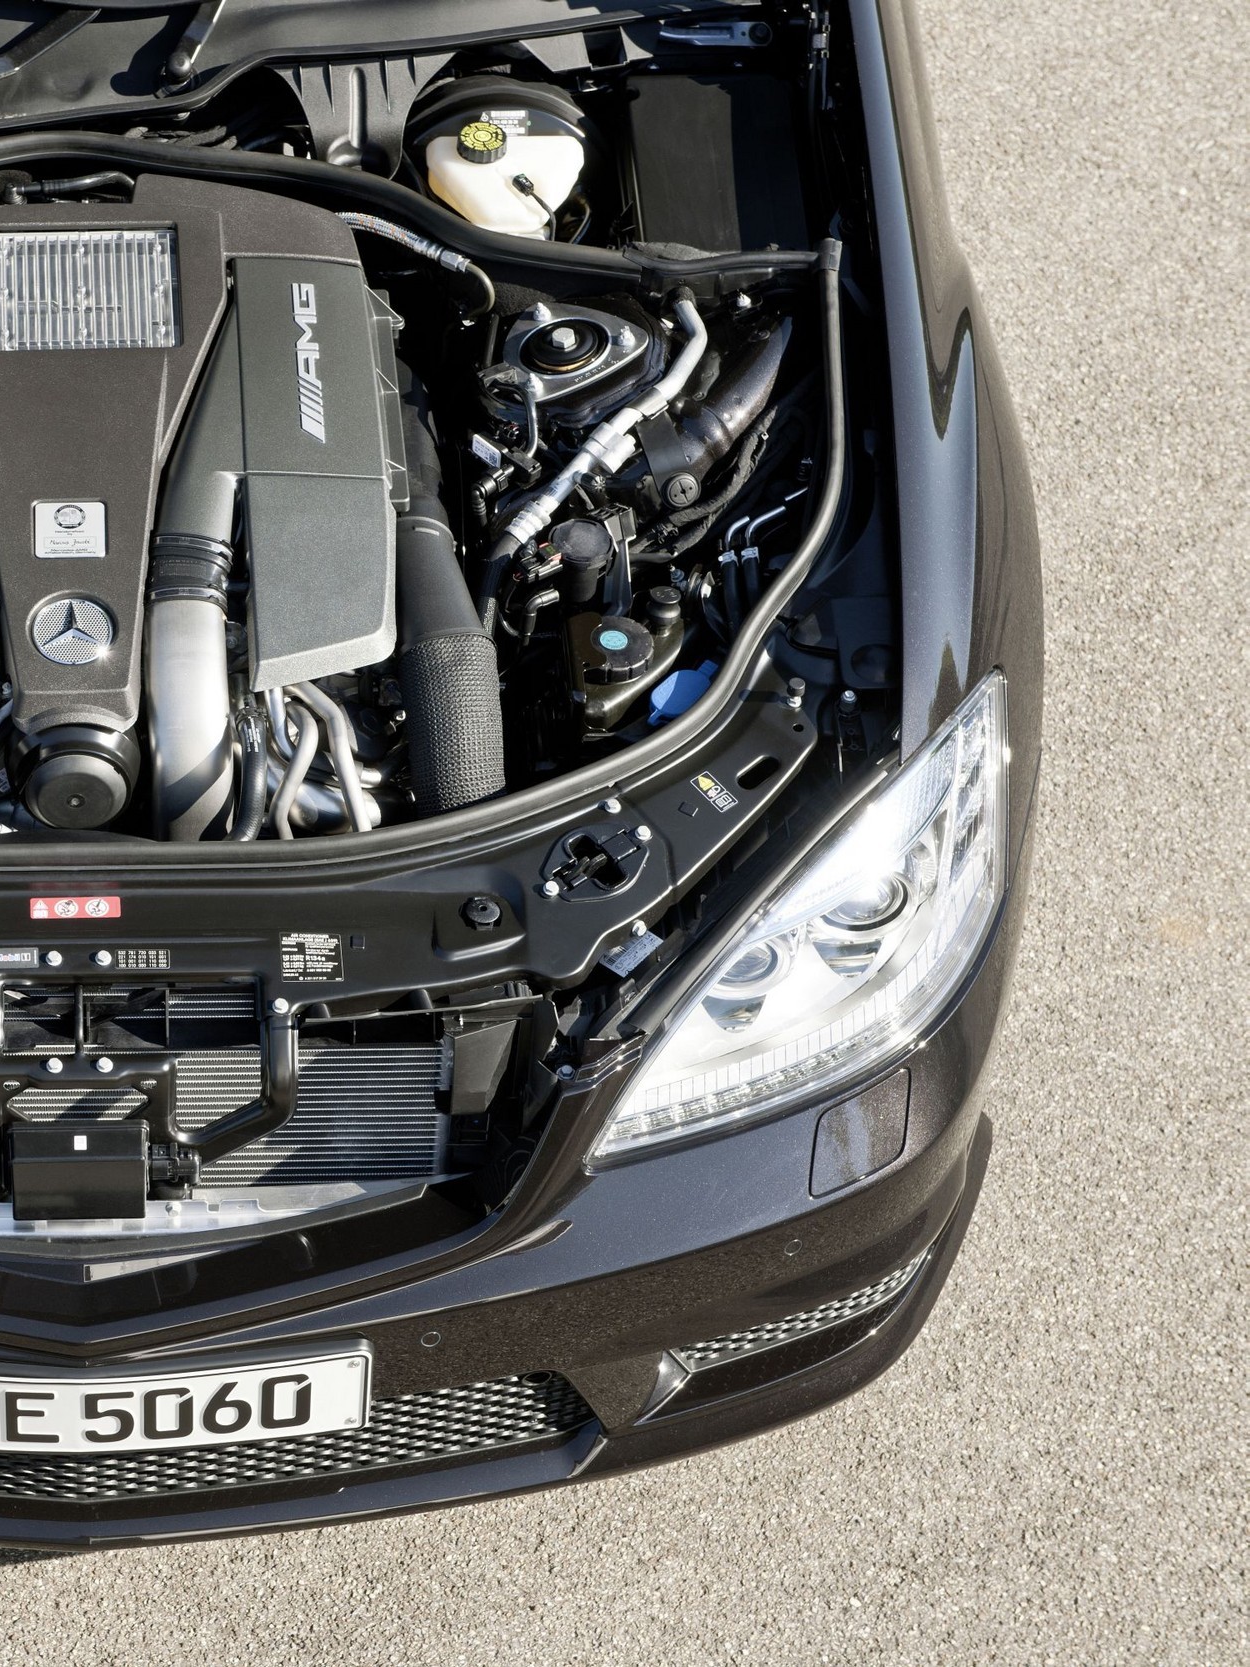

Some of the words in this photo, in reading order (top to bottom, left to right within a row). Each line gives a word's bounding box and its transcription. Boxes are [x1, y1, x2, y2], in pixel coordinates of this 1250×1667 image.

[291, 282, 323, 390] AMG
[4, 1391, 61, 1443] E
[83, 1373, 313, 1444] 5060
